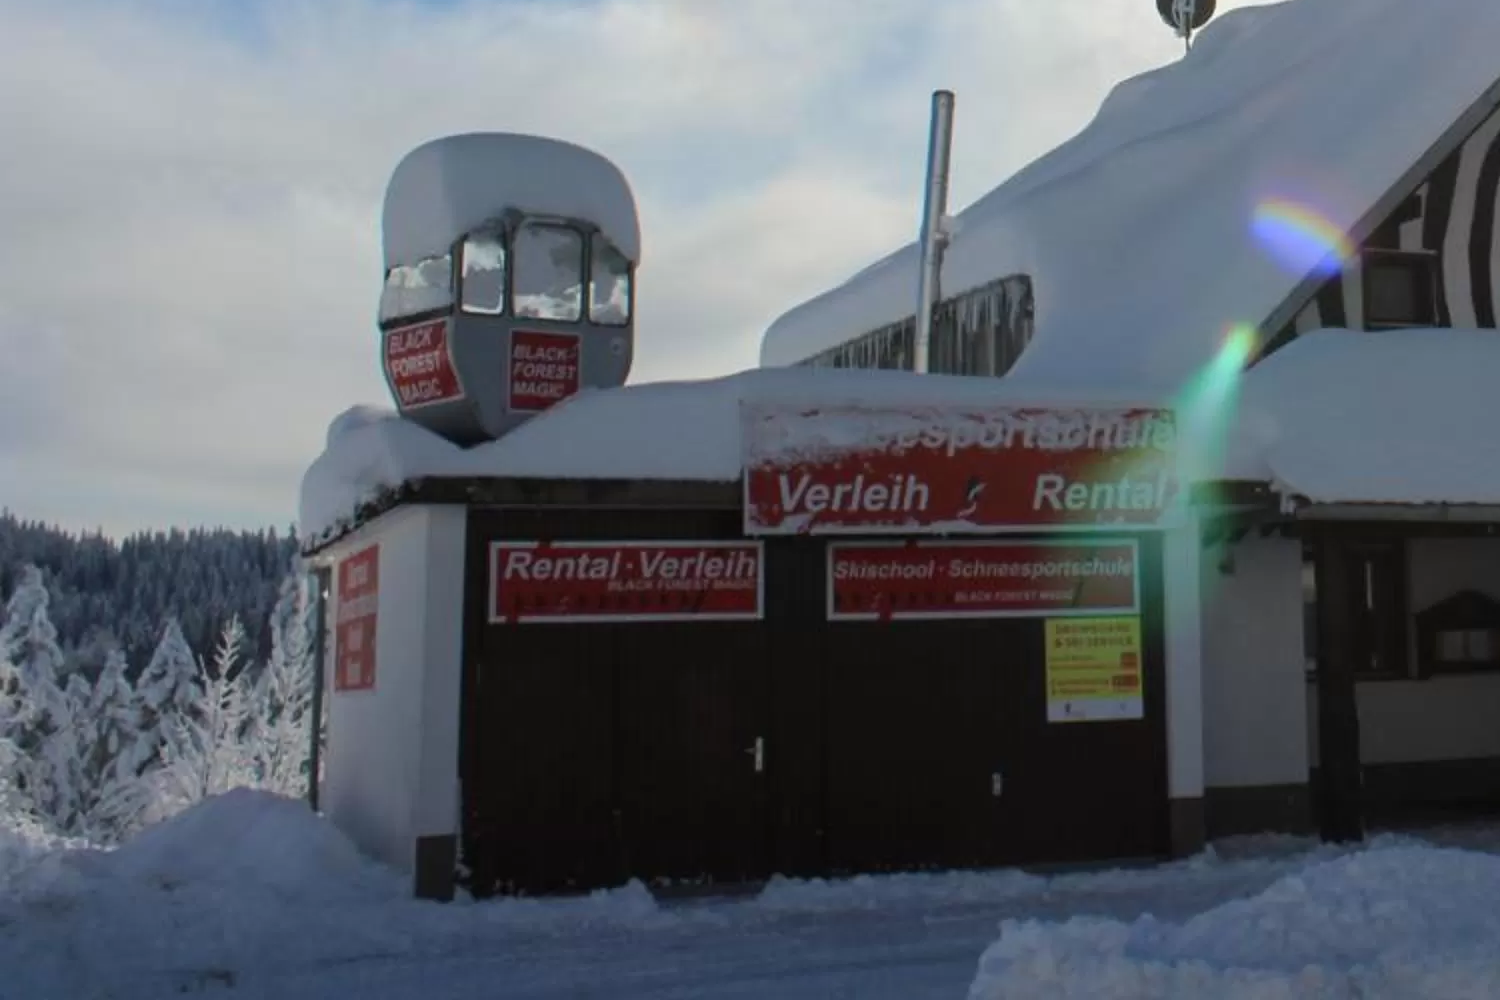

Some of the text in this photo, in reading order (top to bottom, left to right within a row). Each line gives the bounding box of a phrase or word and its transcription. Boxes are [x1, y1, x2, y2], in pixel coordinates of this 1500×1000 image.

[390, 325, 433, 354] BLACK
[513, 343, 568, 361] BLACK
[390, 349, 442, 377] FOREST
[513, 360, 577, 380] FOREST
[400, 377, 443, 402] MAGIC
[512, 380, 565, 398] MAGIC
[777, 472, 1167, 513] Verleih Rental
[503, 550, 755, 580] Rental Verleih
[833, 556, 1132, 580] Skischool Schneesportschule
